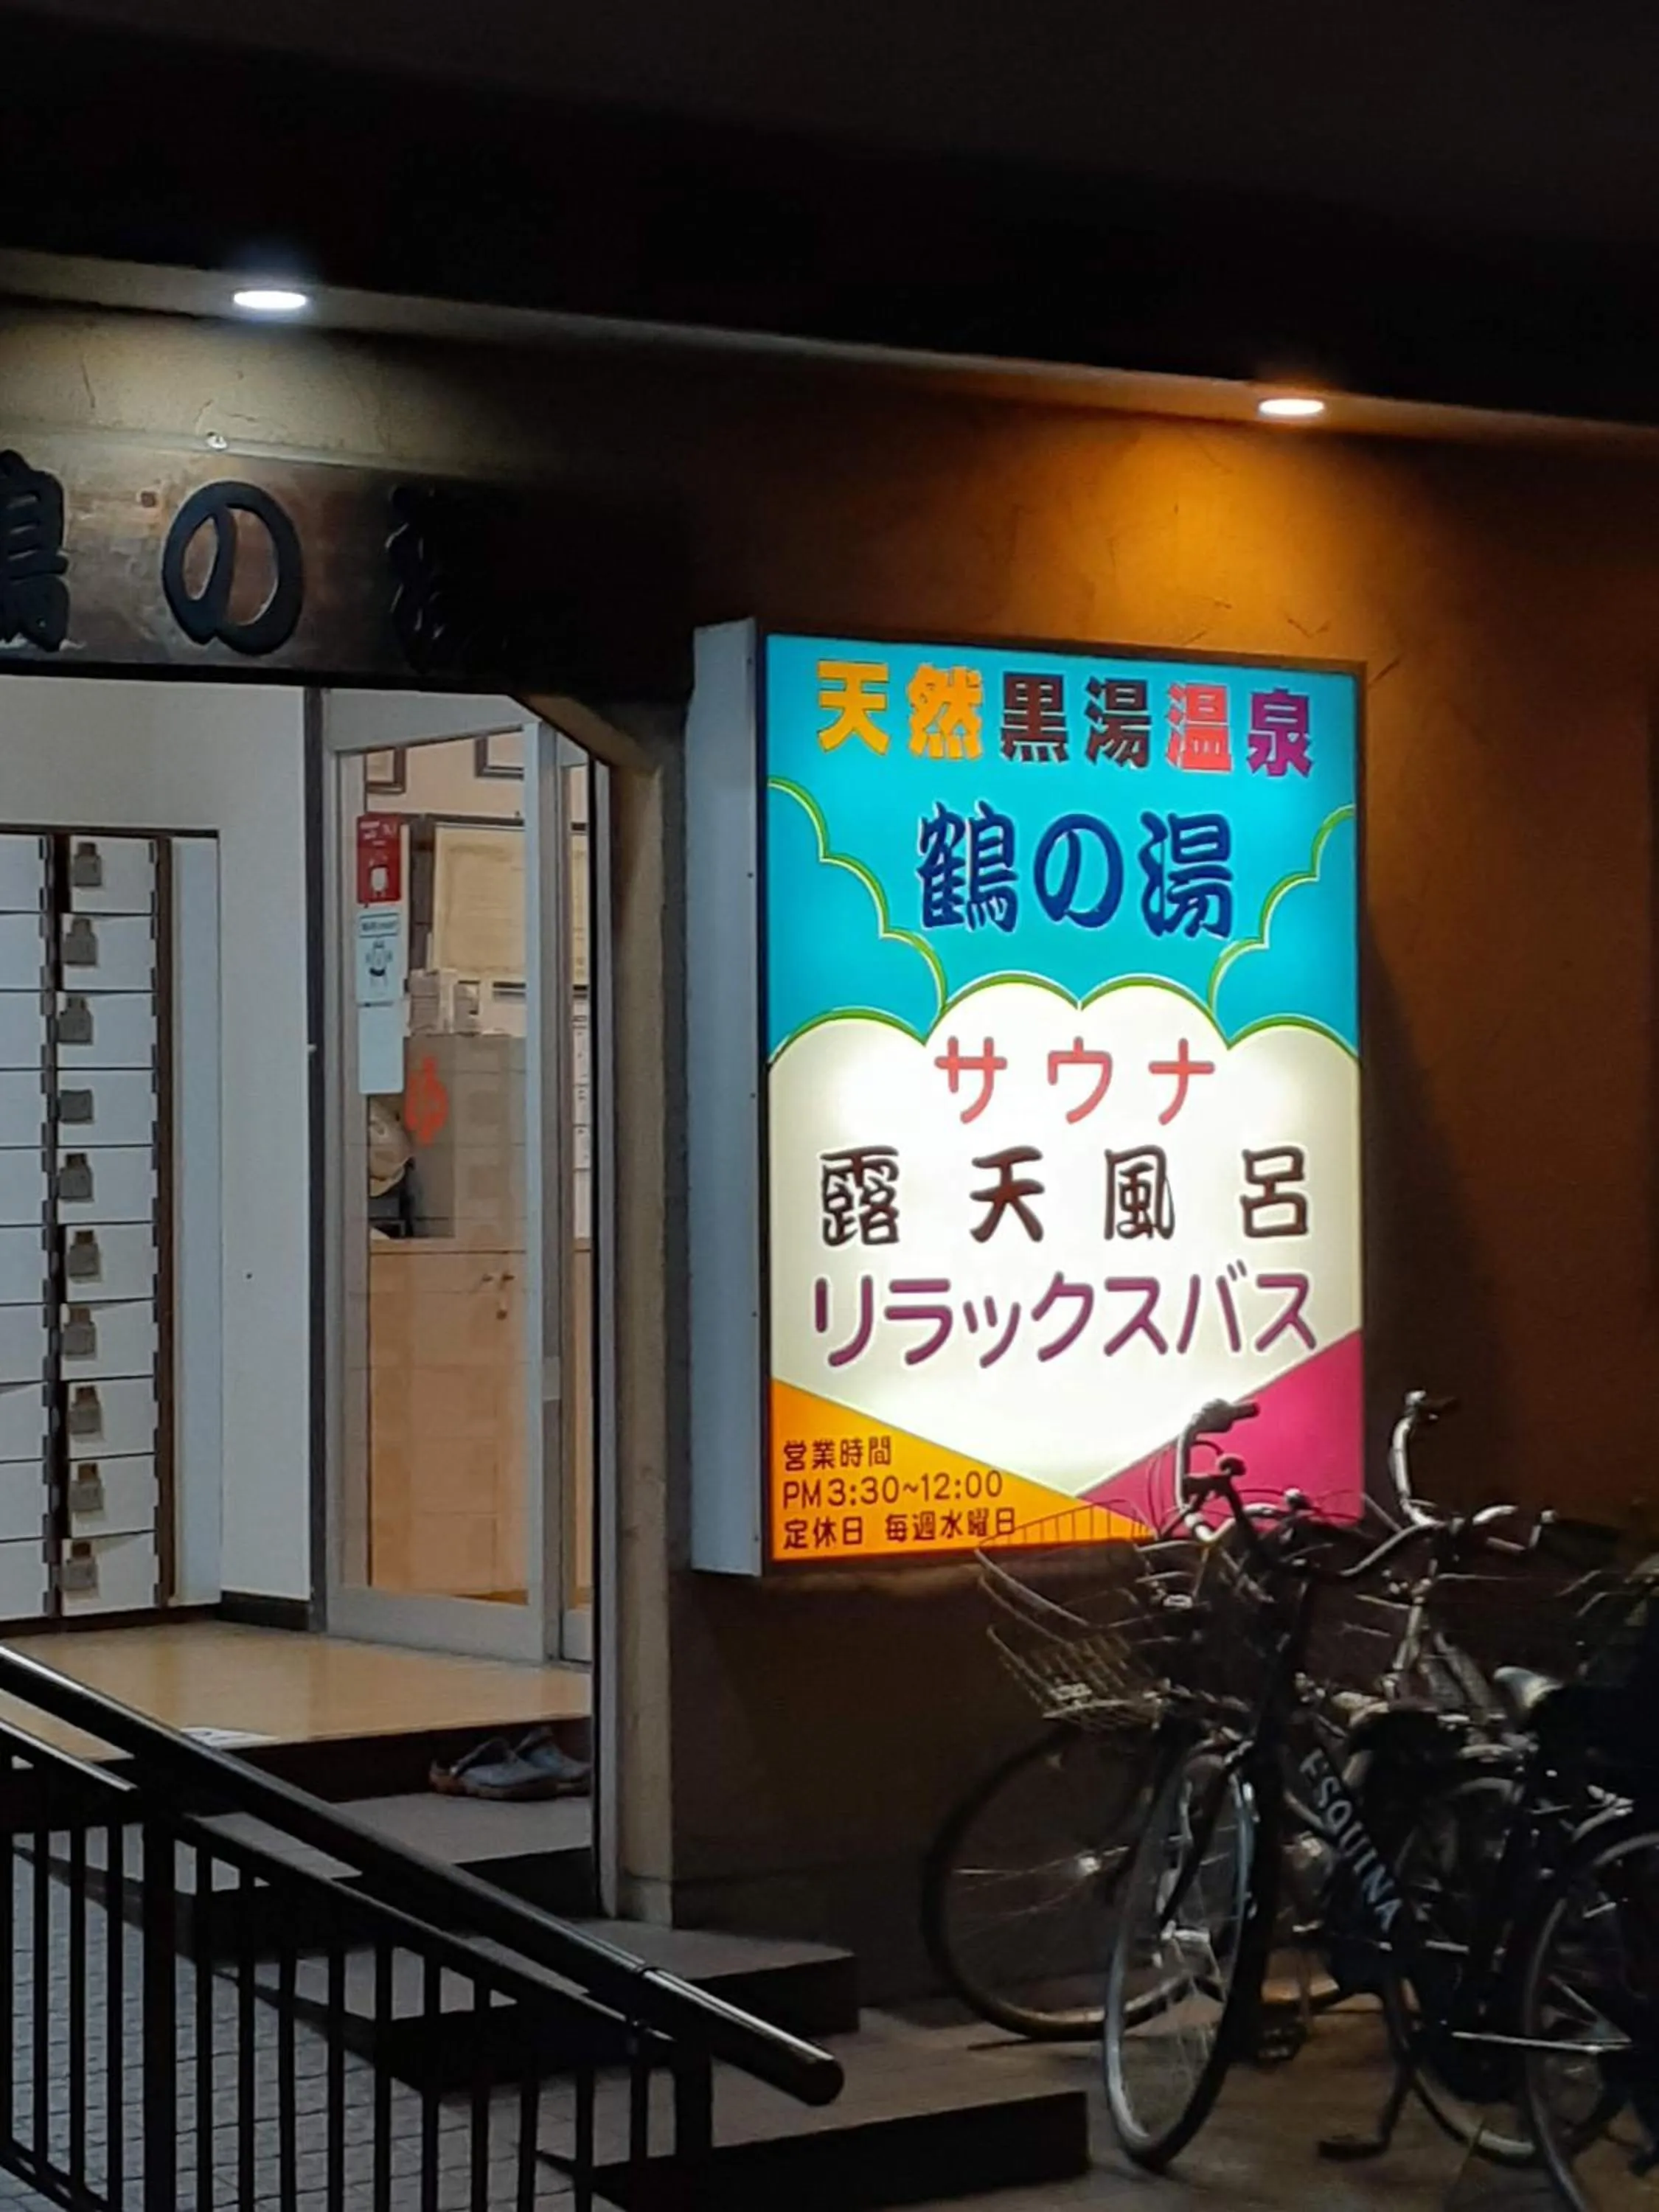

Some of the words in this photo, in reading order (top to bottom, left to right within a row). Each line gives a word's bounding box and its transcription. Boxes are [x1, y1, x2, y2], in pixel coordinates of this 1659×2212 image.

[816, 661, 1313, 779] 天然黒湯温泉
[917, 801, 1232, 937] 鶴の湯
[935, 1036, 1215, 1124] サウナ
[820, 1146, 1310, 1246] 露天風呂
[814, 1260, 1316, 1368] リラックスバス
[783, 1436, 892, 1471] 営業時間
[784, 1516, 863, 1550] 定休日
[886, 1508, 1016, 1542] 毎週水曜日
